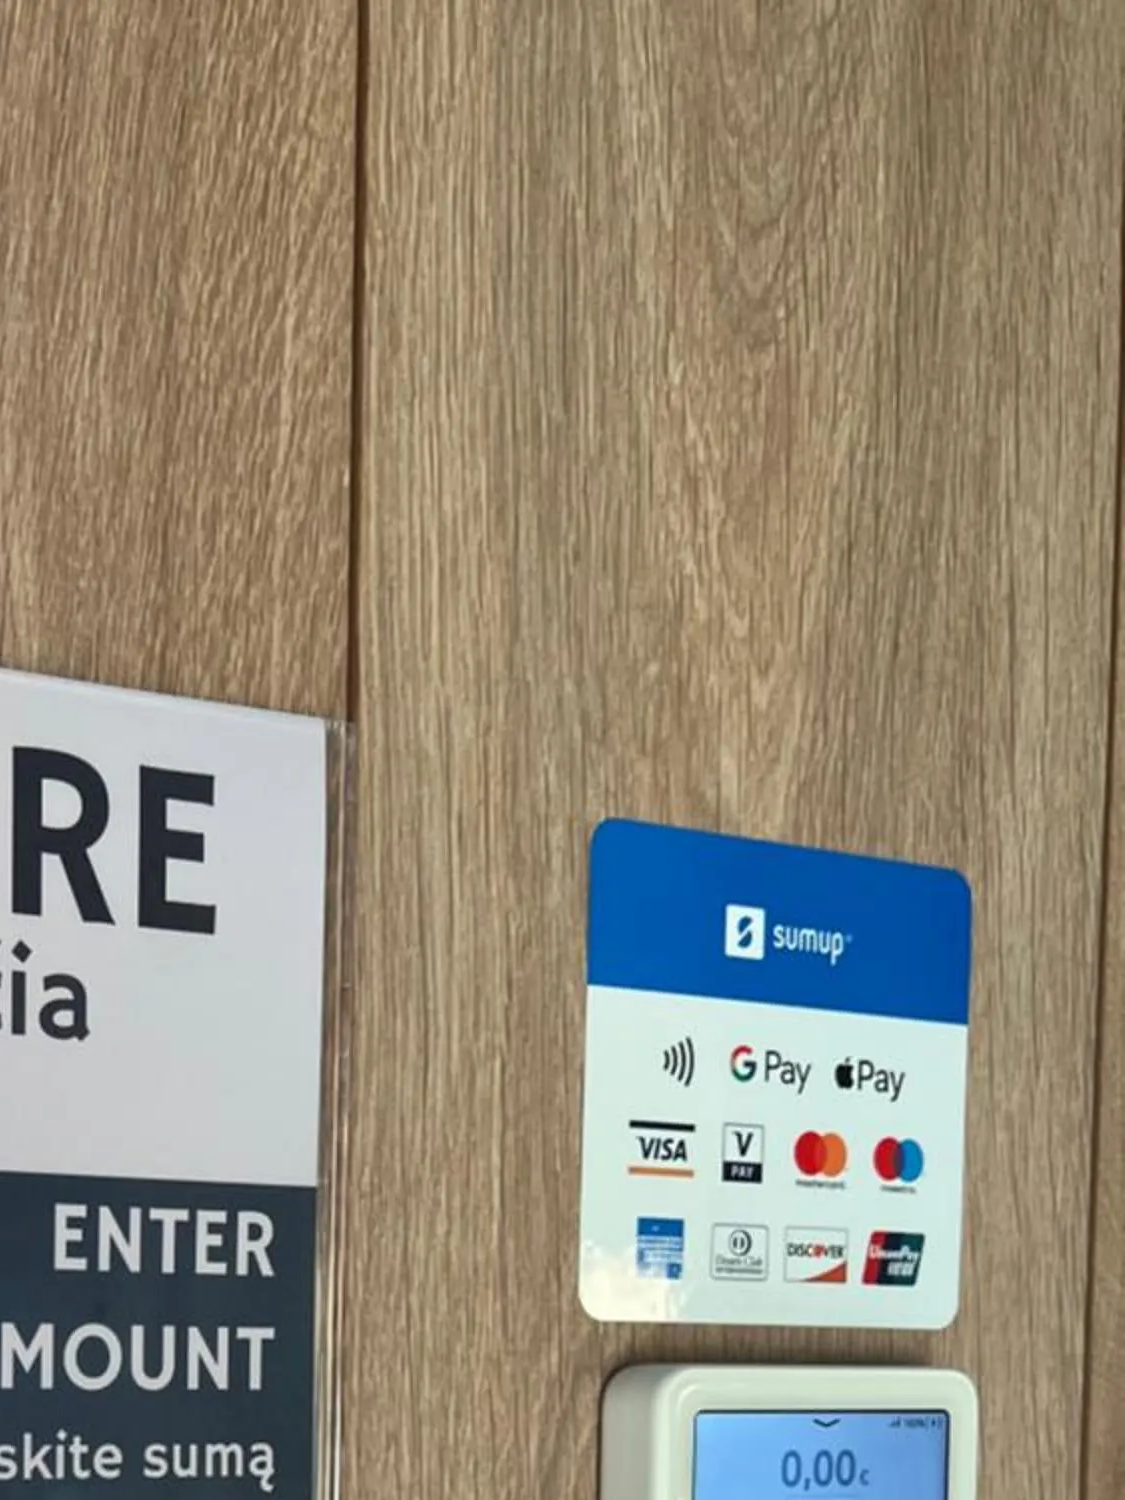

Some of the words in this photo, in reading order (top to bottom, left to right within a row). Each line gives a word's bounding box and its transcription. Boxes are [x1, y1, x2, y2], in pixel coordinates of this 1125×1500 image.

[772, 923, 845, 967] sumup
[764, 1050, 812, 1096] Pay
[856, 1058, 906, 1103] Pay
[636, 1135, 688, 1162] VISA
[732, 1130, 754, 1157] V
[730, 1165, 756, 1179] PAY
[53, 1202, 276, 1278] ENTER
[785, 1241, 845, 1260] DISCOVER
[142, 1440, 276, 1494] sumą
[781, 1449, 857, 1492] 0,00
